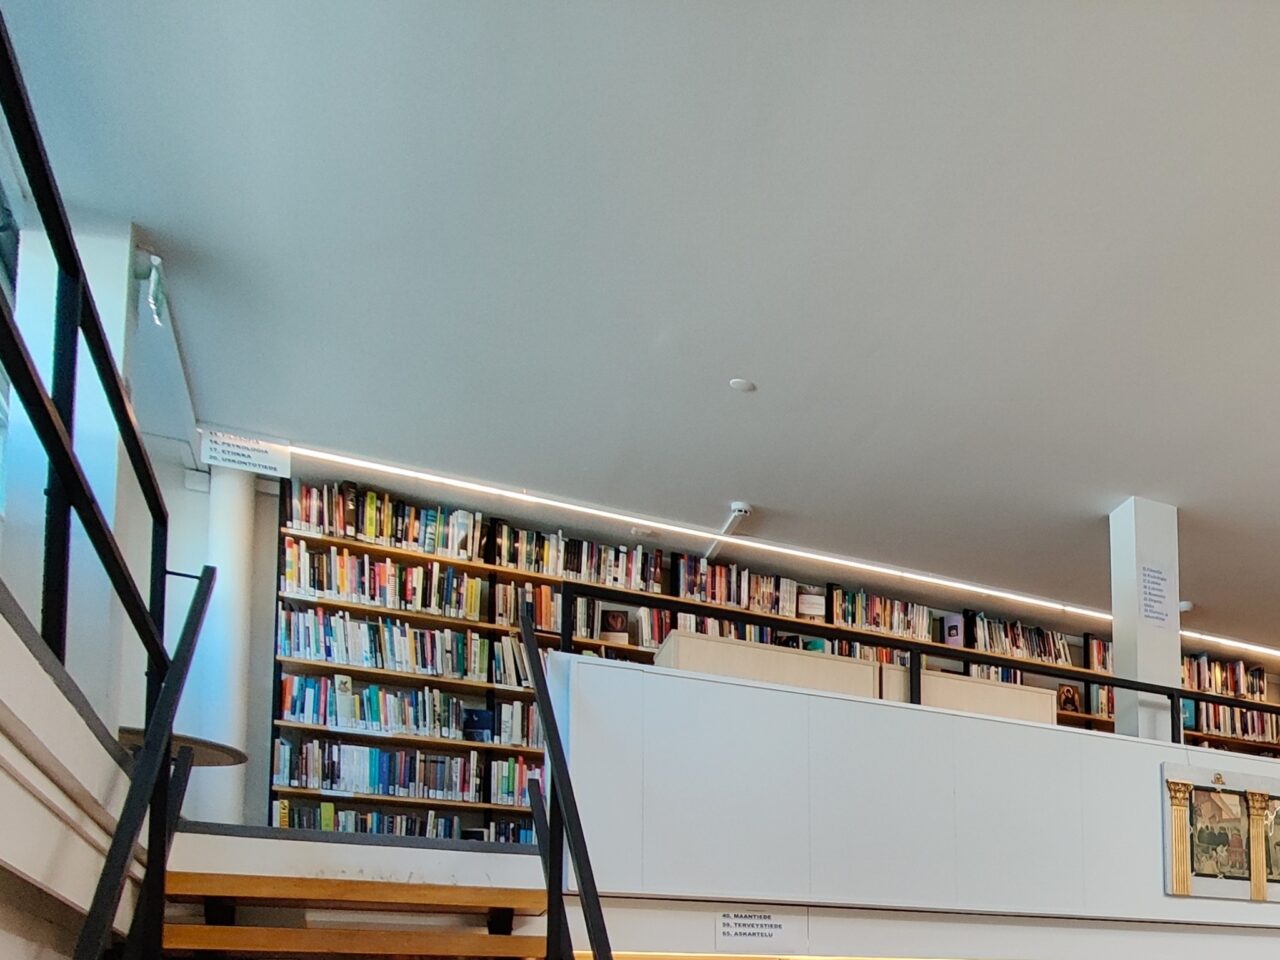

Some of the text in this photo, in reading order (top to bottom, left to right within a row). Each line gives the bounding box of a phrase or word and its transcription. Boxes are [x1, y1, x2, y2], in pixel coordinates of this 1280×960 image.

[222, 457, 279, 471] USKONTOTIEDE
[733, 913, 772, 921] MAANTIEDE
[733, 922, 783, 930] TERVEYSTIEDE
